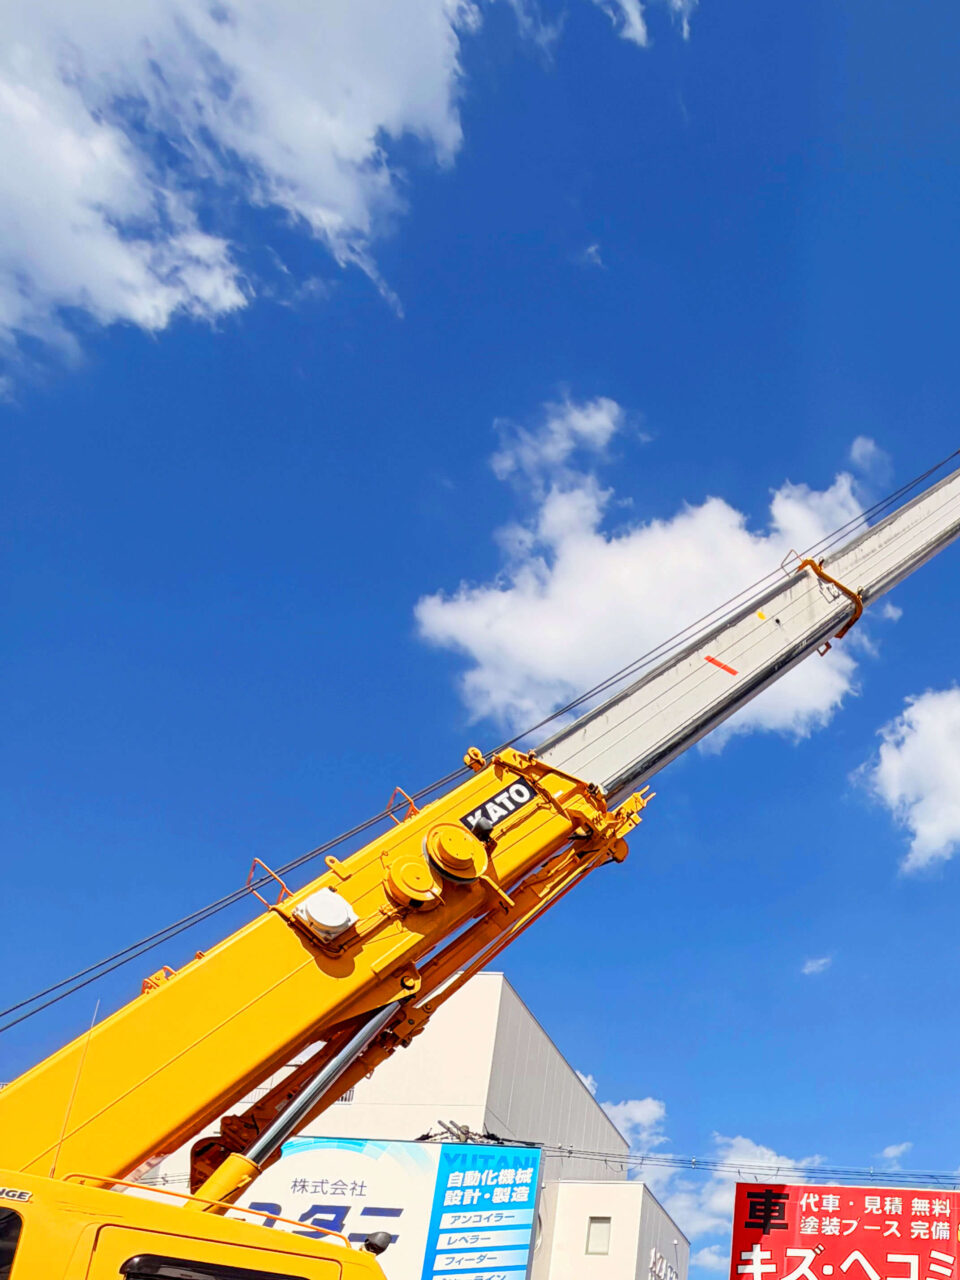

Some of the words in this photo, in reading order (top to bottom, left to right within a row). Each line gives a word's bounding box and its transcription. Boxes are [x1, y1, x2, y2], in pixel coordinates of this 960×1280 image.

[466, 783, 530, 825] KATO
[290, 1177, 367, 1197] 株式会社
[446, 1168, 534, 1188] 自動化機械
[443, 1186, 530, 1207] 設計・製造
[744, 1189, 790, 1235] 車
[911, 1197, 951, 1218] 無料
[449, 1213, 515, 1225] アンコイラー
[800, 1216, 901, 1238] 塗装ブース
[910, 1221, 951, 1240] 完備
[447, 1234, 491, 1246] レベラー
[444, 1253, 498, 1266] フィーダー
